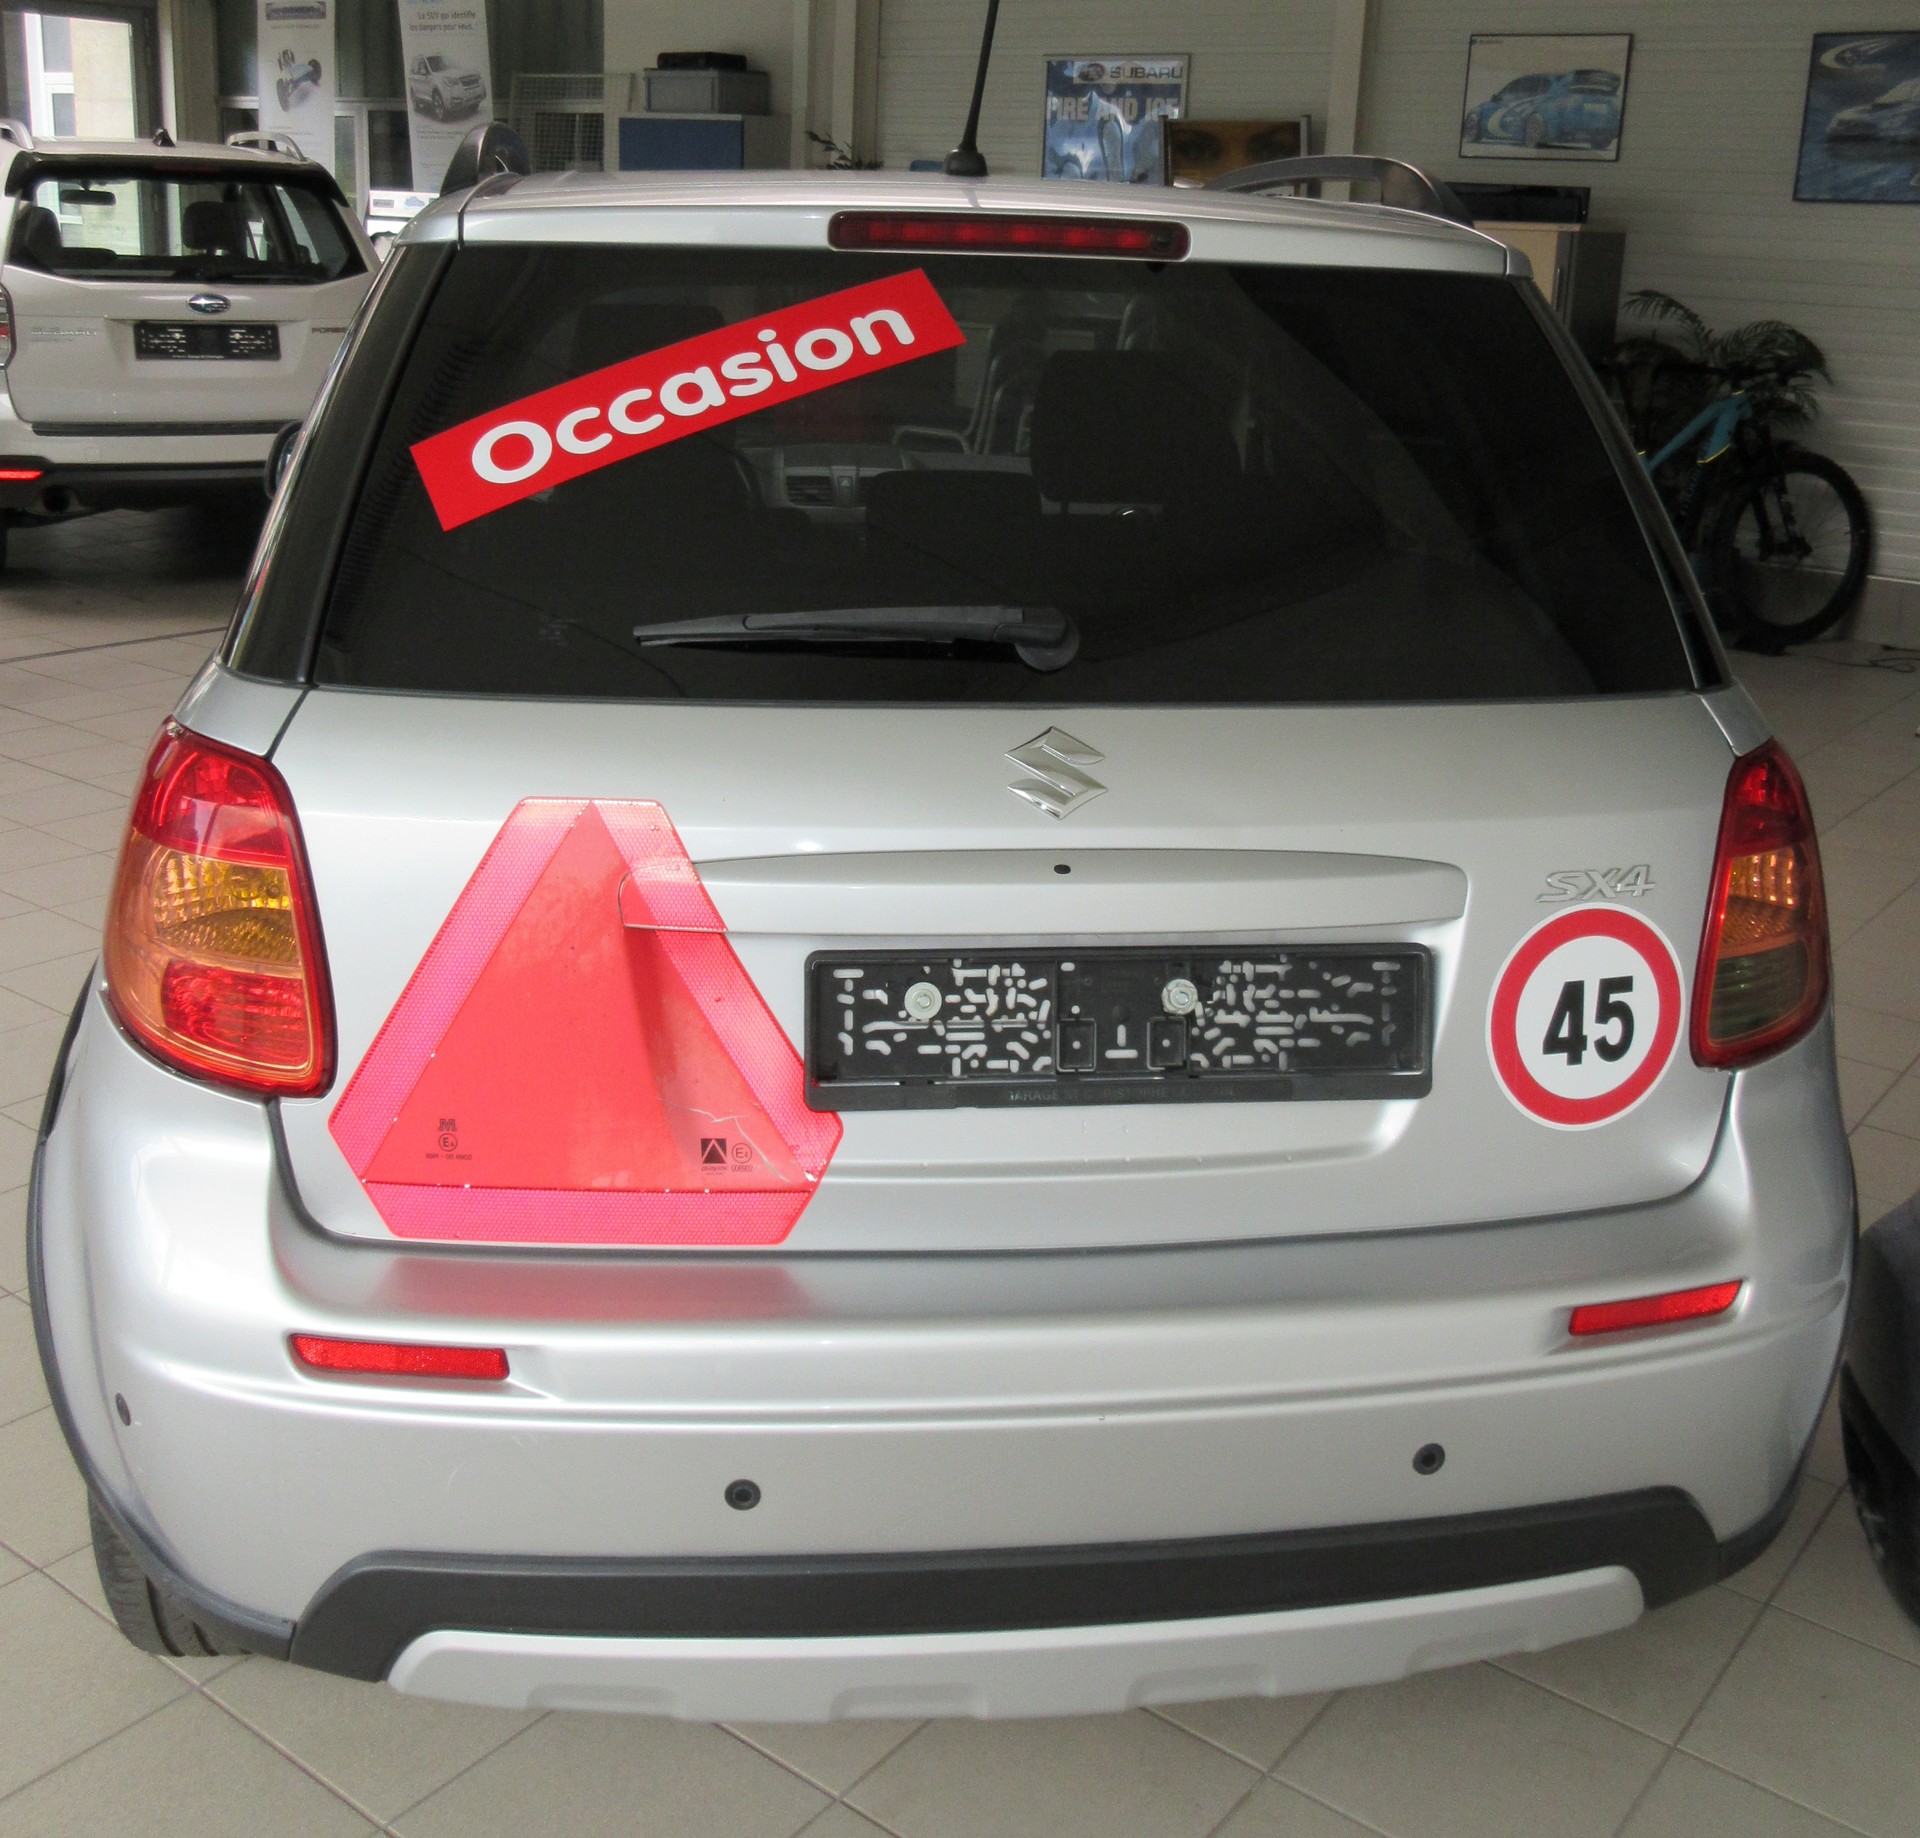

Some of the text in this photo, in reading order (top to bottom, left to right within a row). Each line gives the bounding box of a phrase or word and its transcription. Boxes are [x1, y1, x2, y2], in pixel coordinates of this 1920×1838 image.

[427, 11, 438, 20] SUV
[1109, 65, 1183, 79] SUBARU
[471, 308, 916, 485] Occasion
[1536, 864, 1657, 903] SX4
[1542, 975, 1635, 1066] 45
